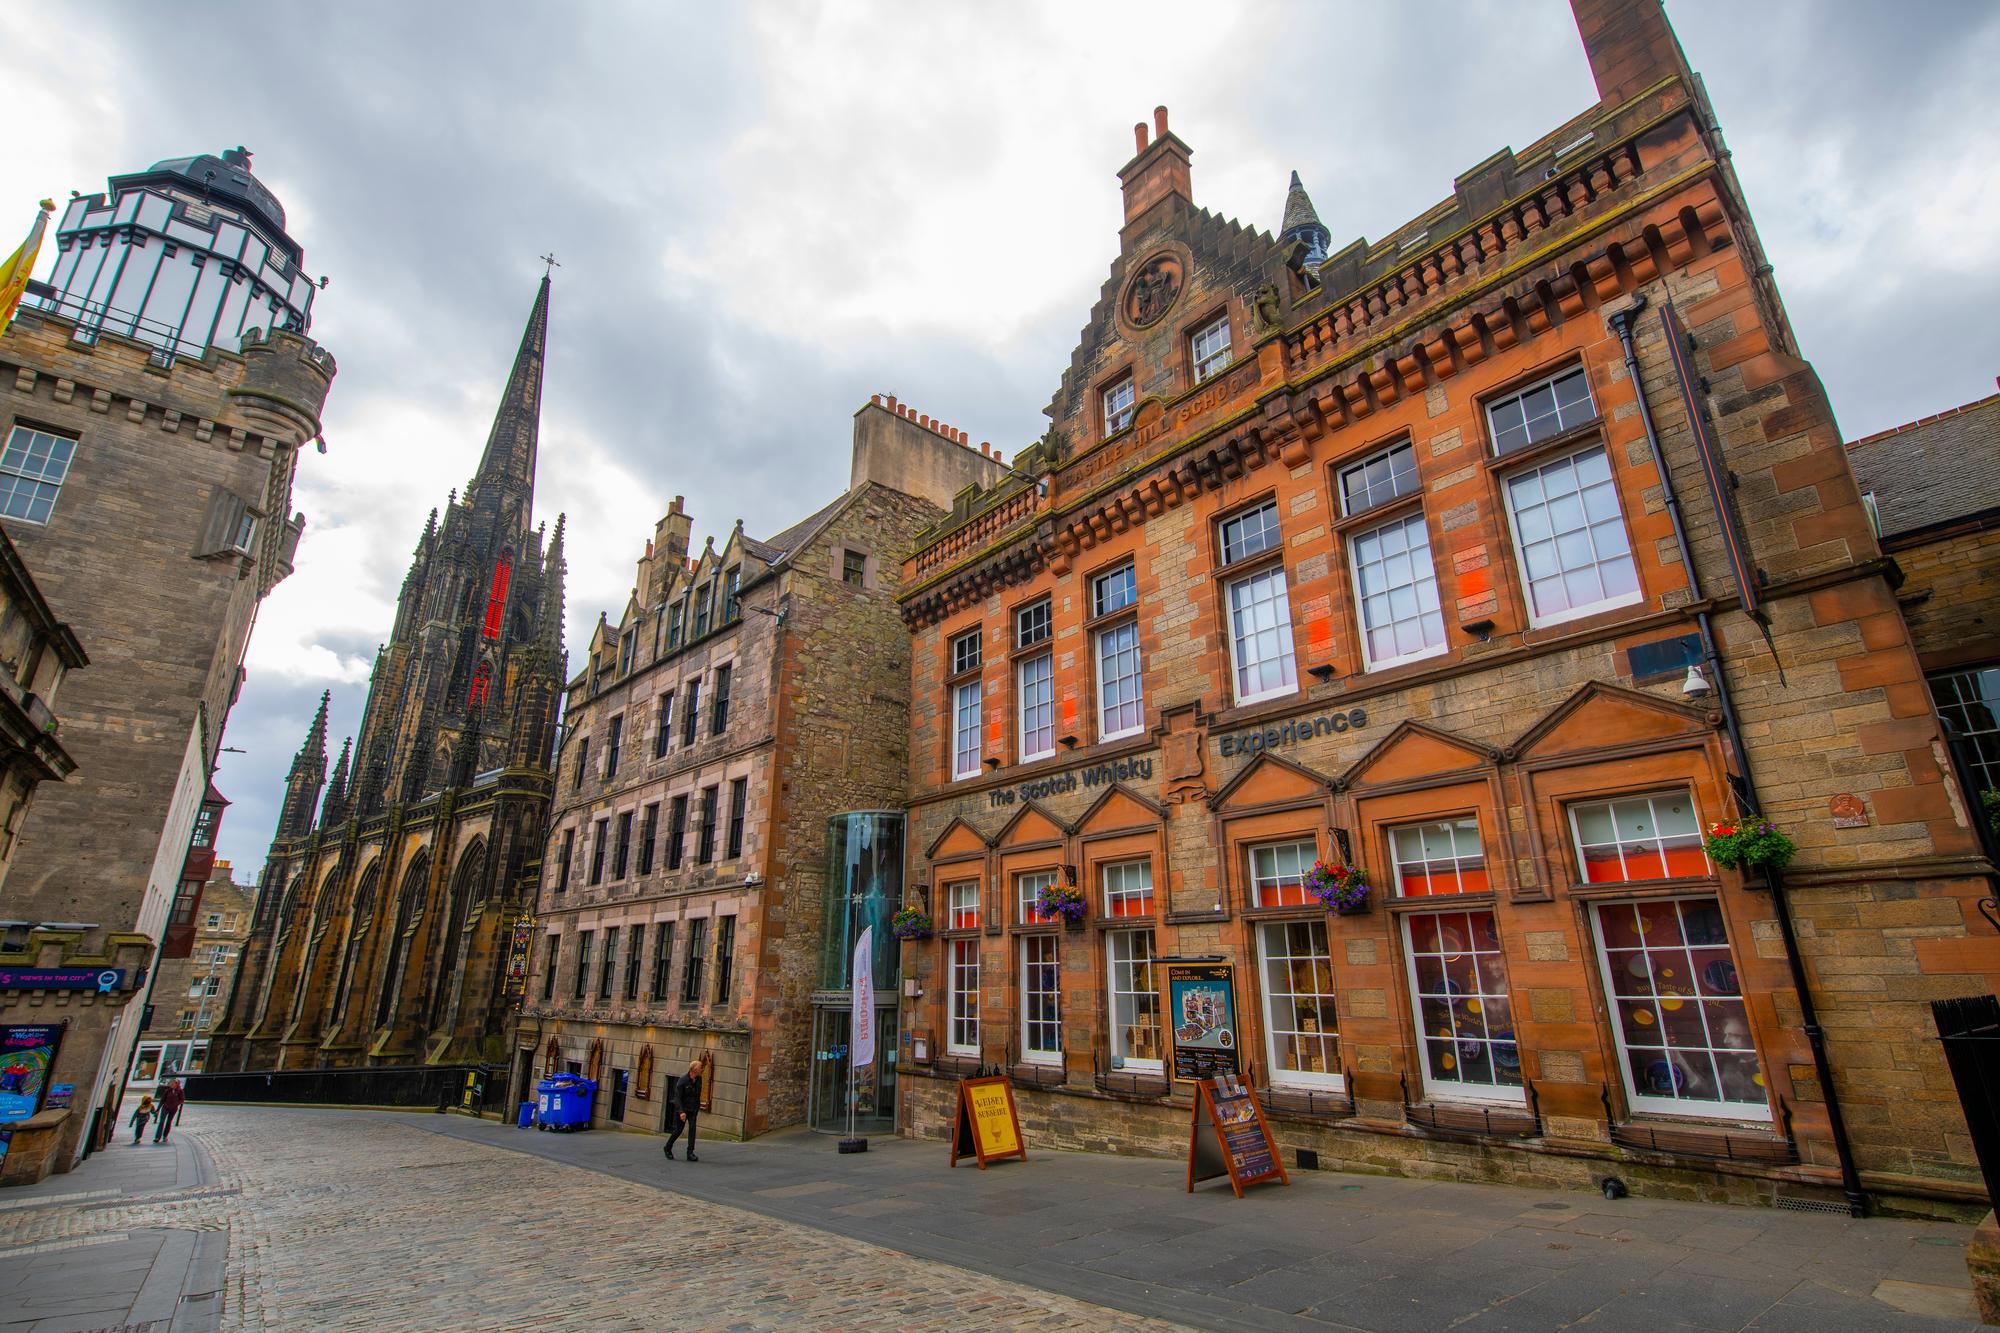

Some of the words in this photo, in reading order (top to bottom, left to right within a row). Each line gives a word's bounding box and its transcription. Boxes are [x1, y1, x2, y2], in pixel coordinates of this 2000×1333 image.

[1065, 442, 1123, 487] CASTLE
[1133, 416, 1171, 450] HILL
[1180, 371, 1255, 421] SCHOOL
[988, 788, 1015, 807] The
[1020, 771, 1077, 802] Scotch
[1081, 757, 1153, 788] Whisky
[1219, 708, 1368, 757] Experience
